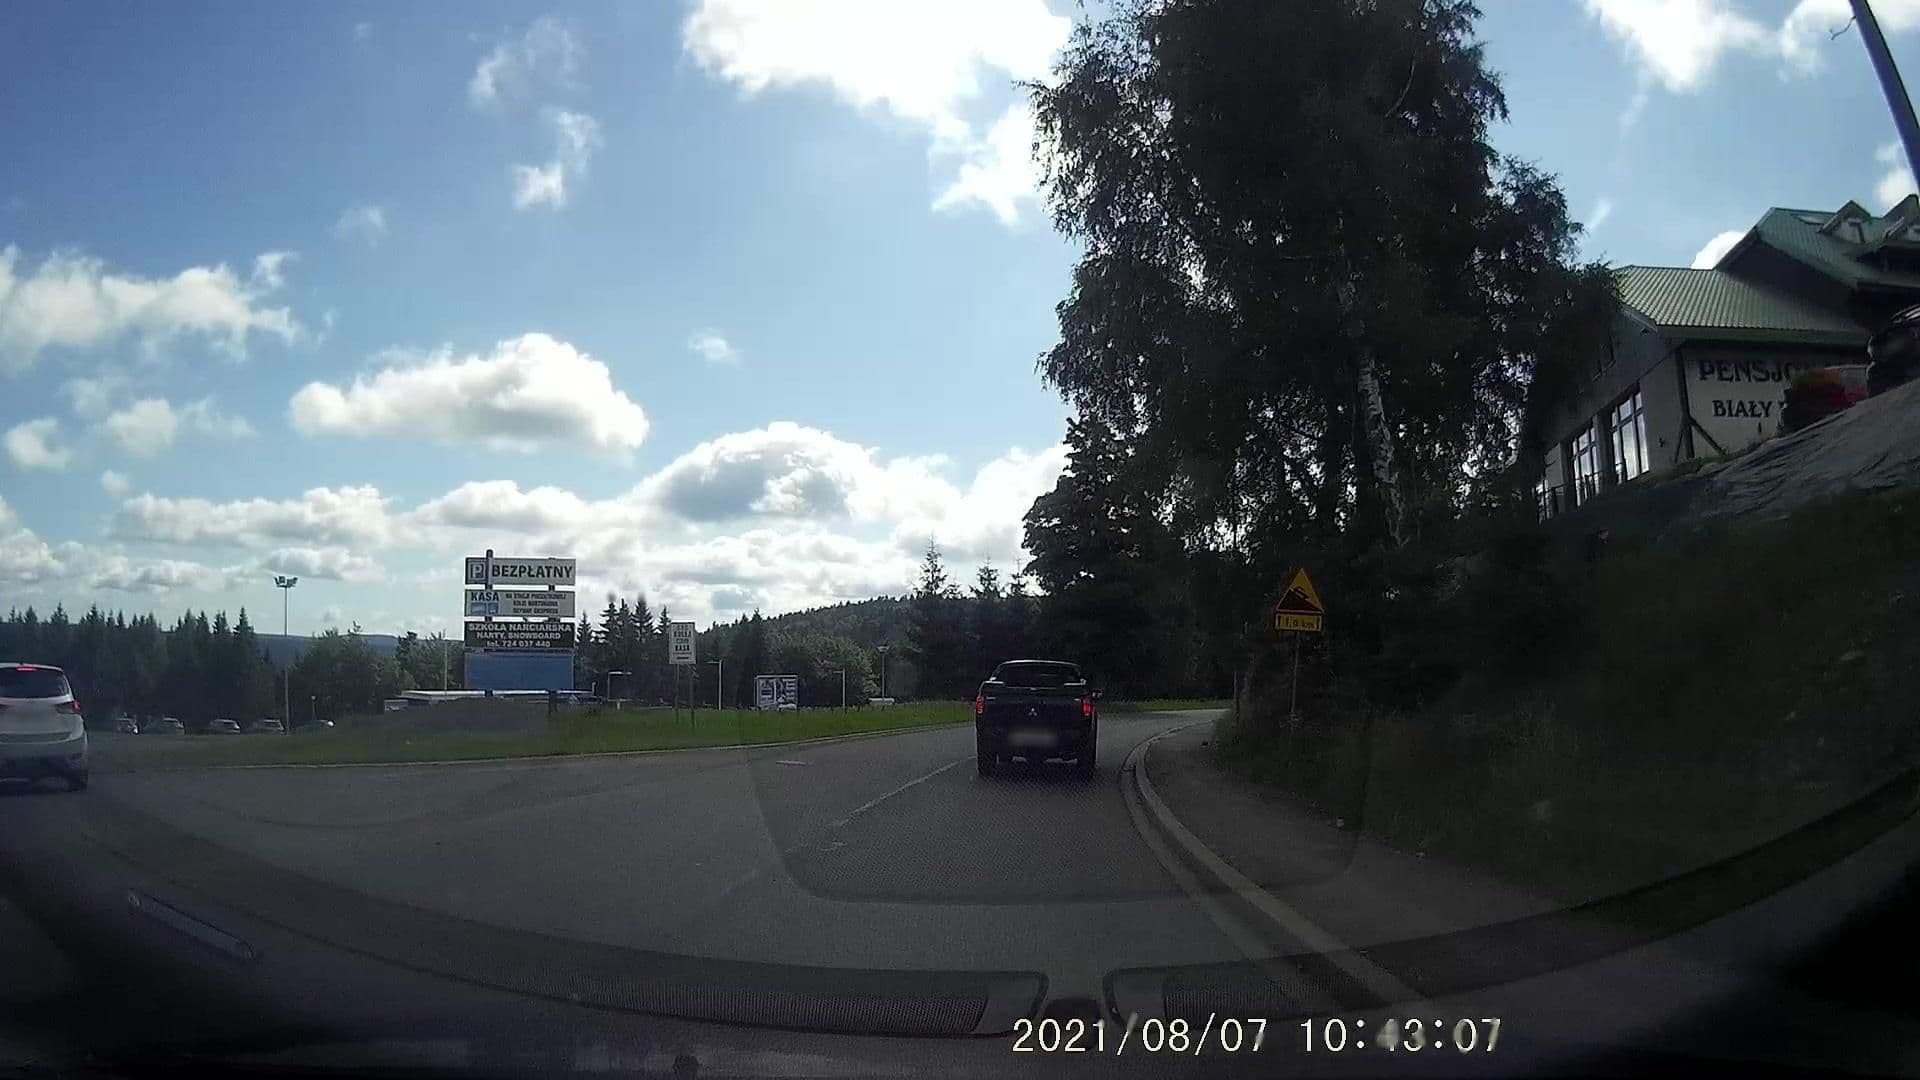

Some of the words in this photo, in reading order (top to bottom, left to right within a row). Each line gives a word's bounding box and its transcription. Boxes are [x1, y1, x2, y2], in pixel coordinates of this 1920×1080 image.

[1712, 400, 1772, 418] BIAŁY
[492, 565, 573, 578] BEZPŁATNY
[471, 592, 499, 601] KASA
[469, 623, 507, 632] SZKOŁA
[509, 623, 572, 632] NARCIARSKA
[508, 632, 561, 640] SNOWBOARD
